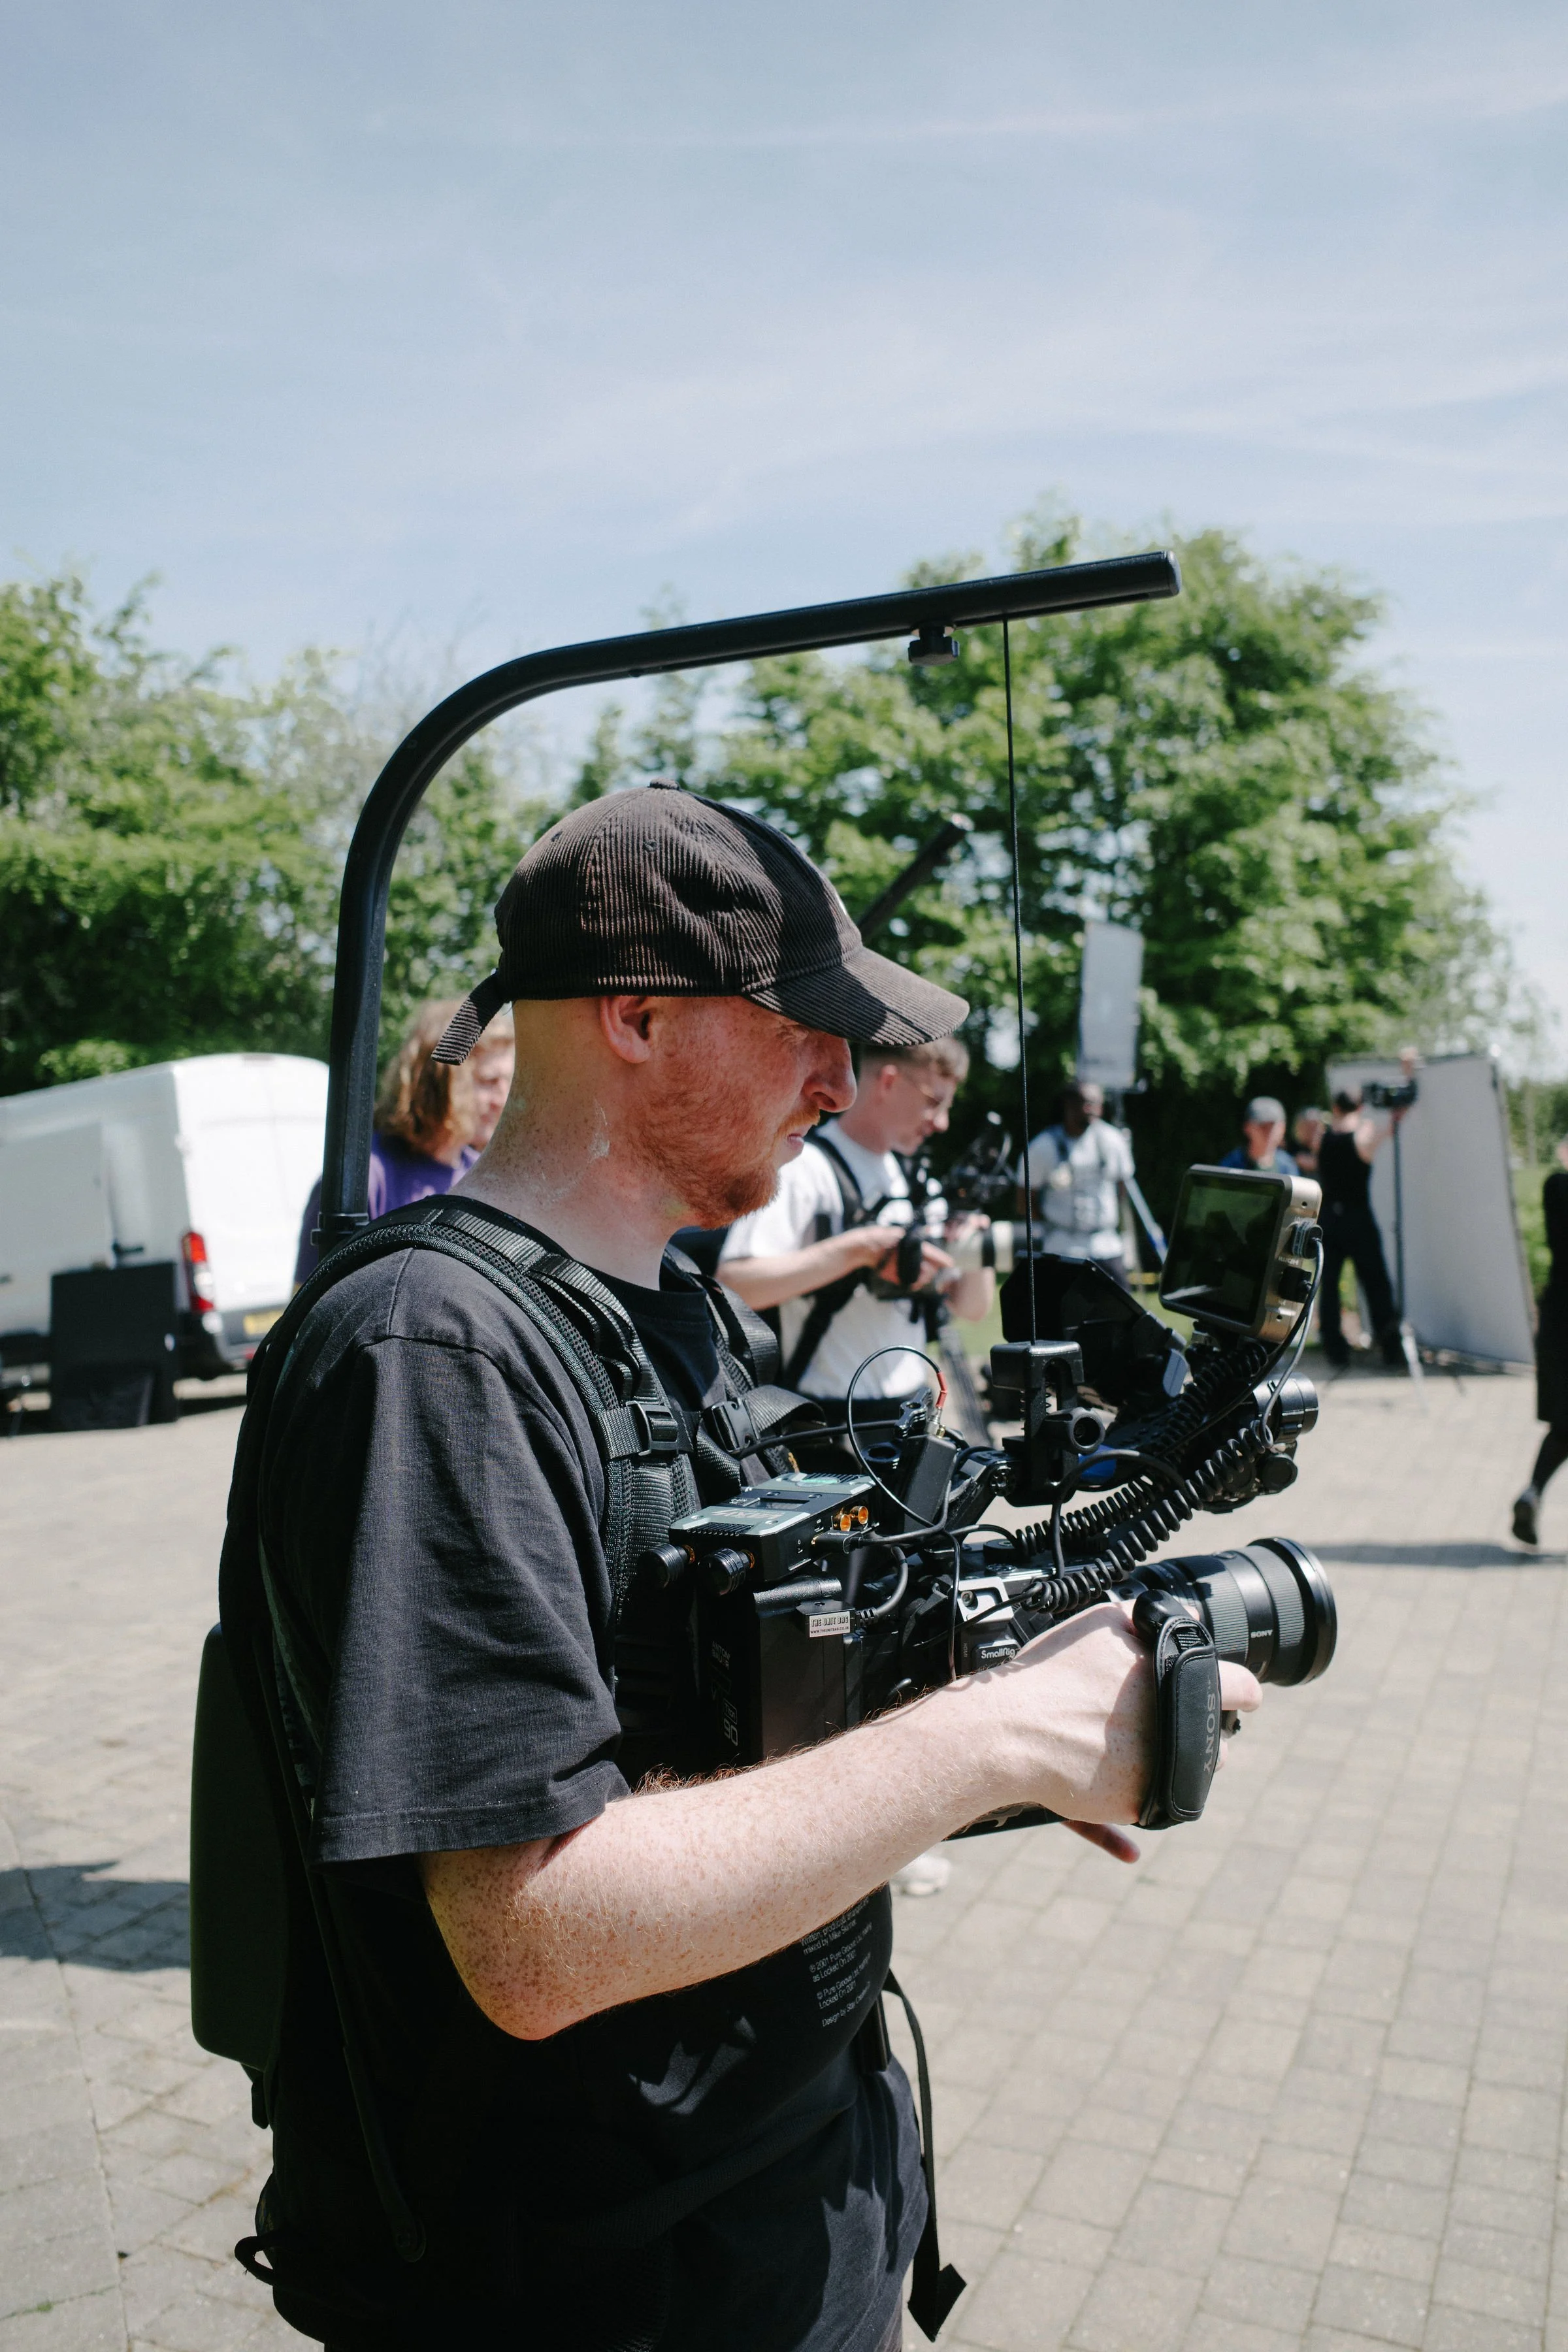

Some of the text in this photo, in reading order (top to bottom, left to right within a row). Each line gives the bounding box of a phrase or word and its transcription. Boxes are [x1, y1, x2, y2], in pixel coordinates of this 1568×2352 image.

[811, 1616, 849, 1627] THE UNIT BAG
[1250, 1629, 1273, 1639] SONY
[981, 1647, 1015, 1659] SmallRig
[724, 1718, 738, 1746] 90
[1203, 1693, 1216, 1772] SONY
